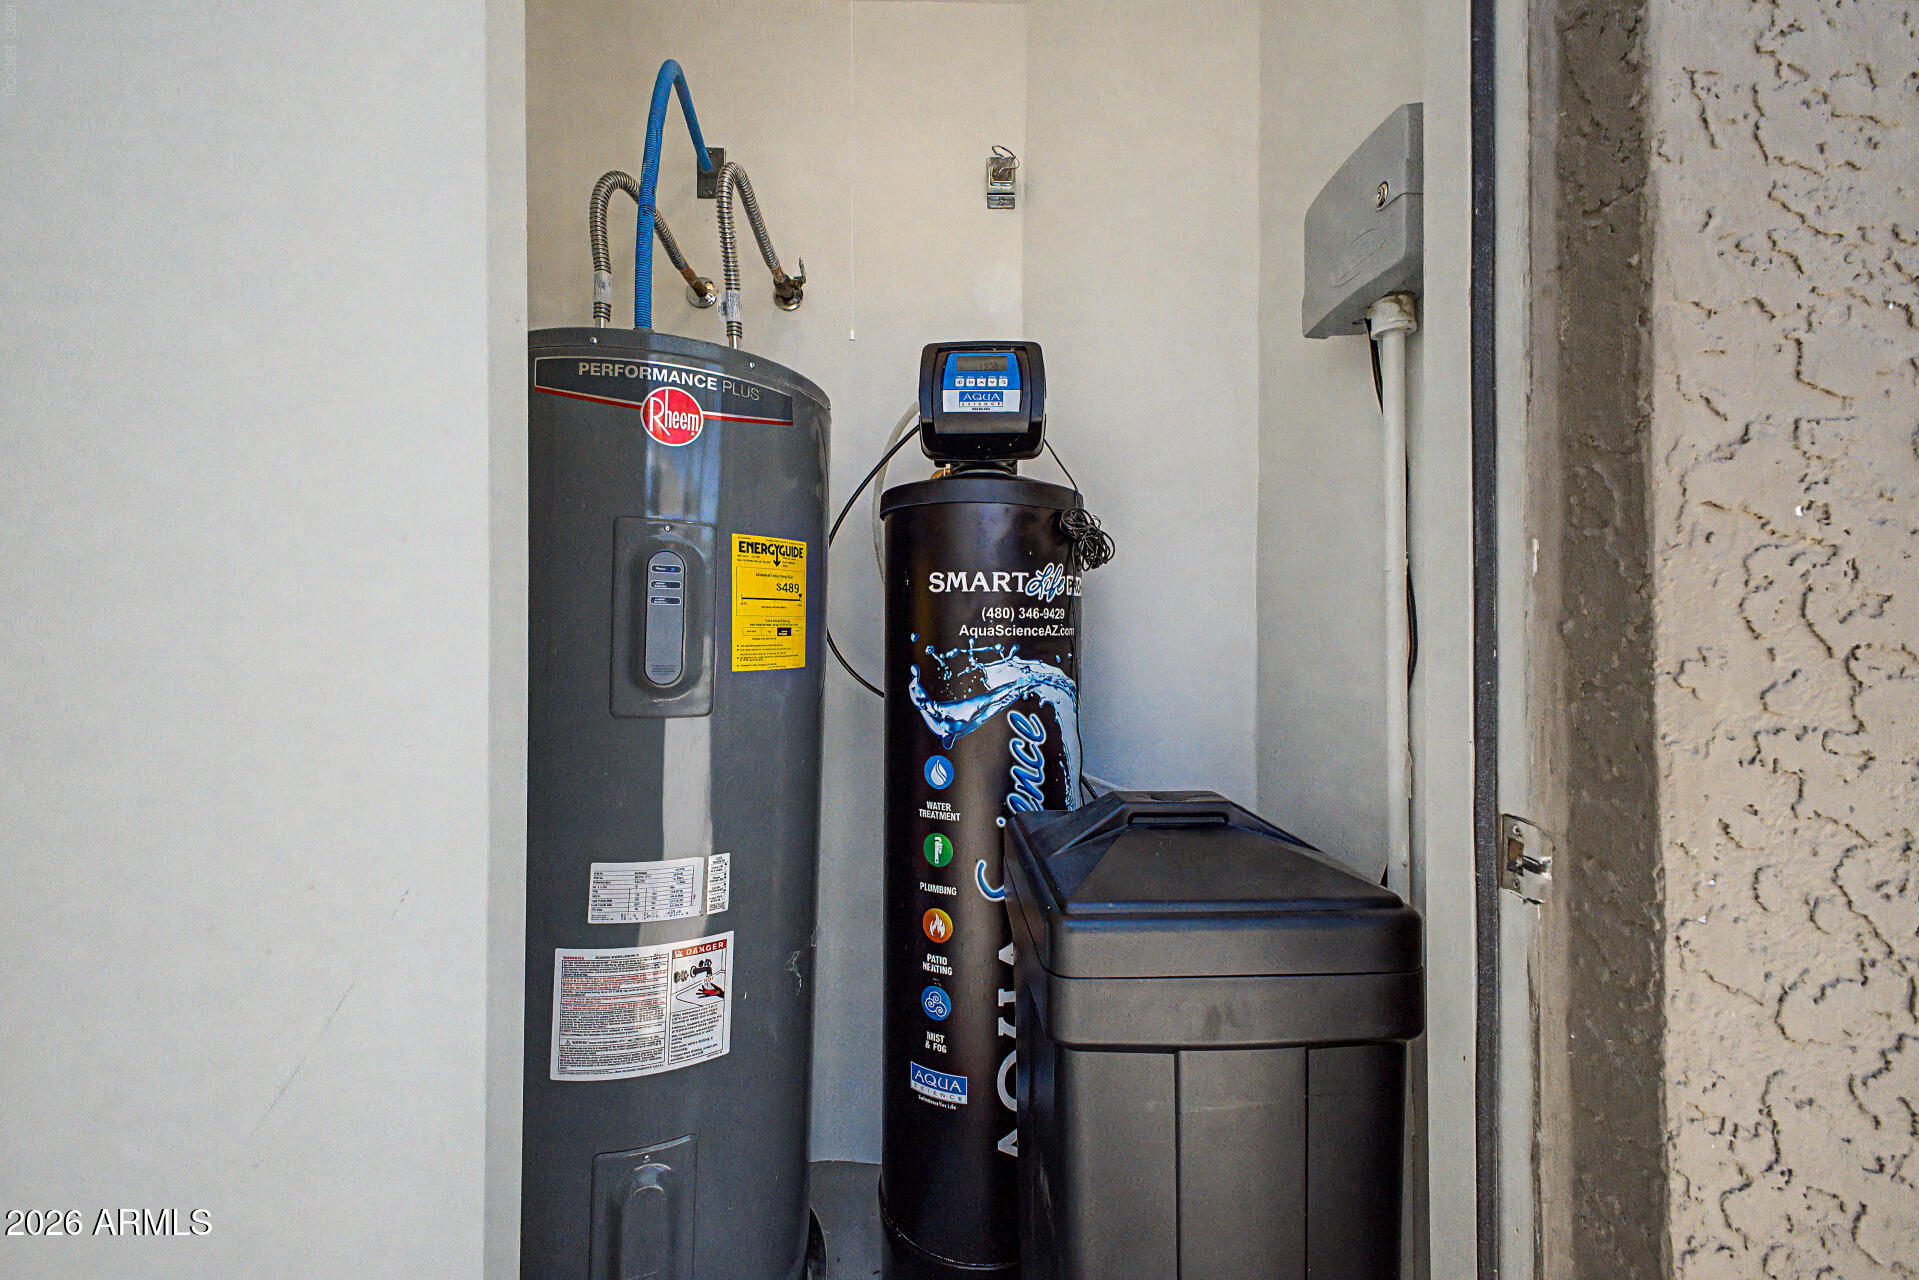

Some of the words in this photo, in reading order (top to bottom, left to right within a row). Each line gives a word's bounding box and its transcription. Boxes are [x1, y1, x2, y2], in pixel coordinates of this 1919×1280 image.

[578, 361, 718, 391] PERFORMANCE
[722, 380, 760, 401] PLUS
[963, 392, 1001, 401] AQUA
[649, 389, 699, 436] Rheem
[738, 540, 804, 564] ENERGYGUIDE
[928, 571, 1029, 593] SMART
[1025, 562, 1066, 603] Life
[981, 607, 1015, 621] (480)
[1018, 607, 1065, 620] 346-9429
[959, 624, 1075, 639] AquaScienceAZ.com
[926, 800, 952, 812] WATER
[918, 808, 961, 822] TREATMENT
[919, 881, 957, 896] PLUMBING
[686, 941, 725, 956] DANGER
[926, 953, 948, 966] PATIO
[922, 961, 953, 976] HEATING
[926, 1030, 945, 1044] MIST
[925, 1039, 931, 1049] &
[932, 1042, 947, 1054] FOG
[914, 1070, 963, 1093] AQUA
